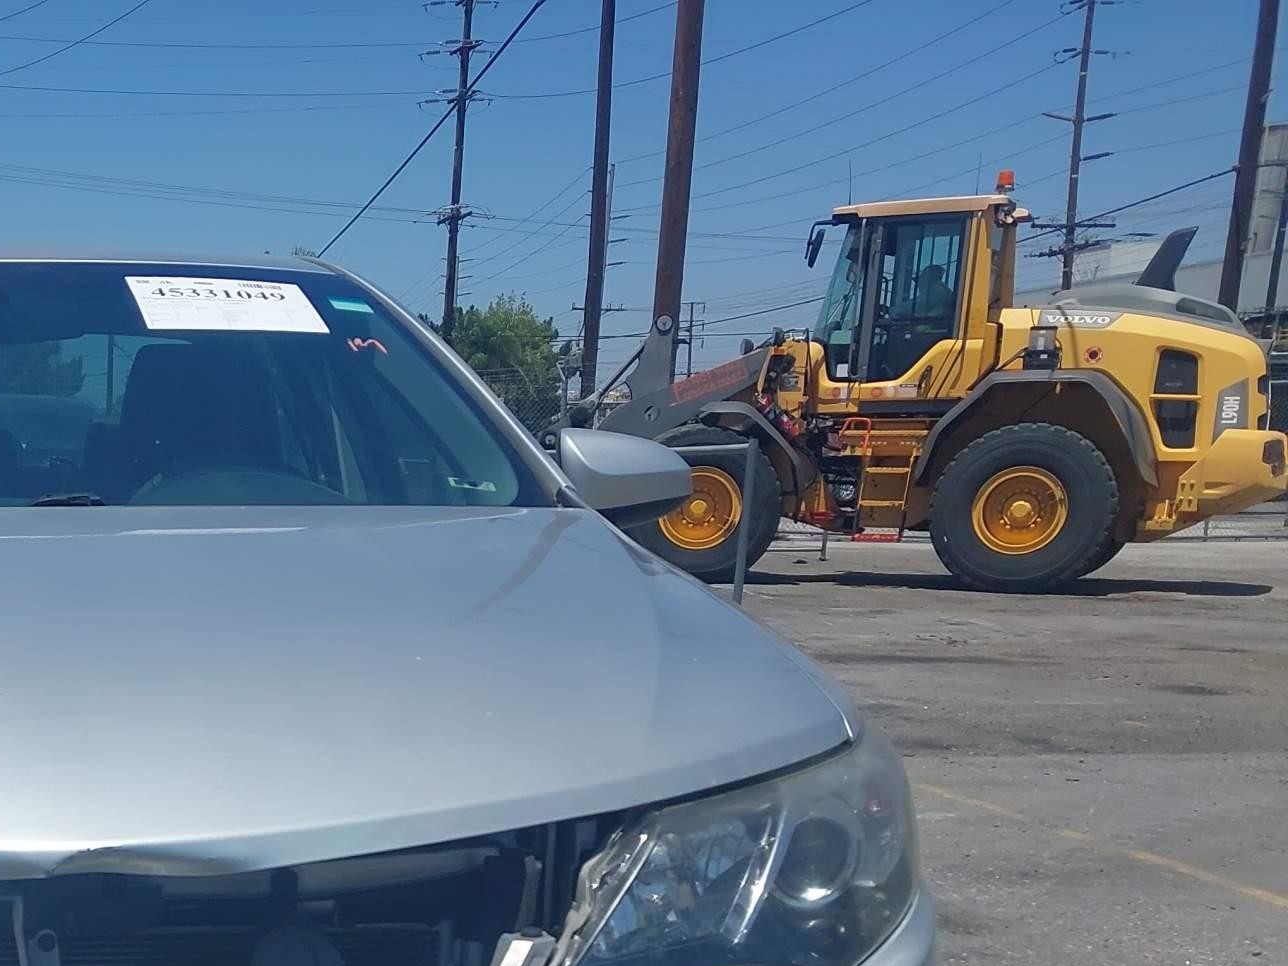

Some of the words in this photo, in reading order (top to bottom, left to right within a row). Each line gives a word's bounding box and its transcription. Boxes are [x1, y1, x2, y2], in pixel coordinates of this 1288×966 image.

[151, 287, 286, 301] 45331049
[1046, 315, 1111, 324] VOLVO
[1221, 396, 1241, 424] L90H
